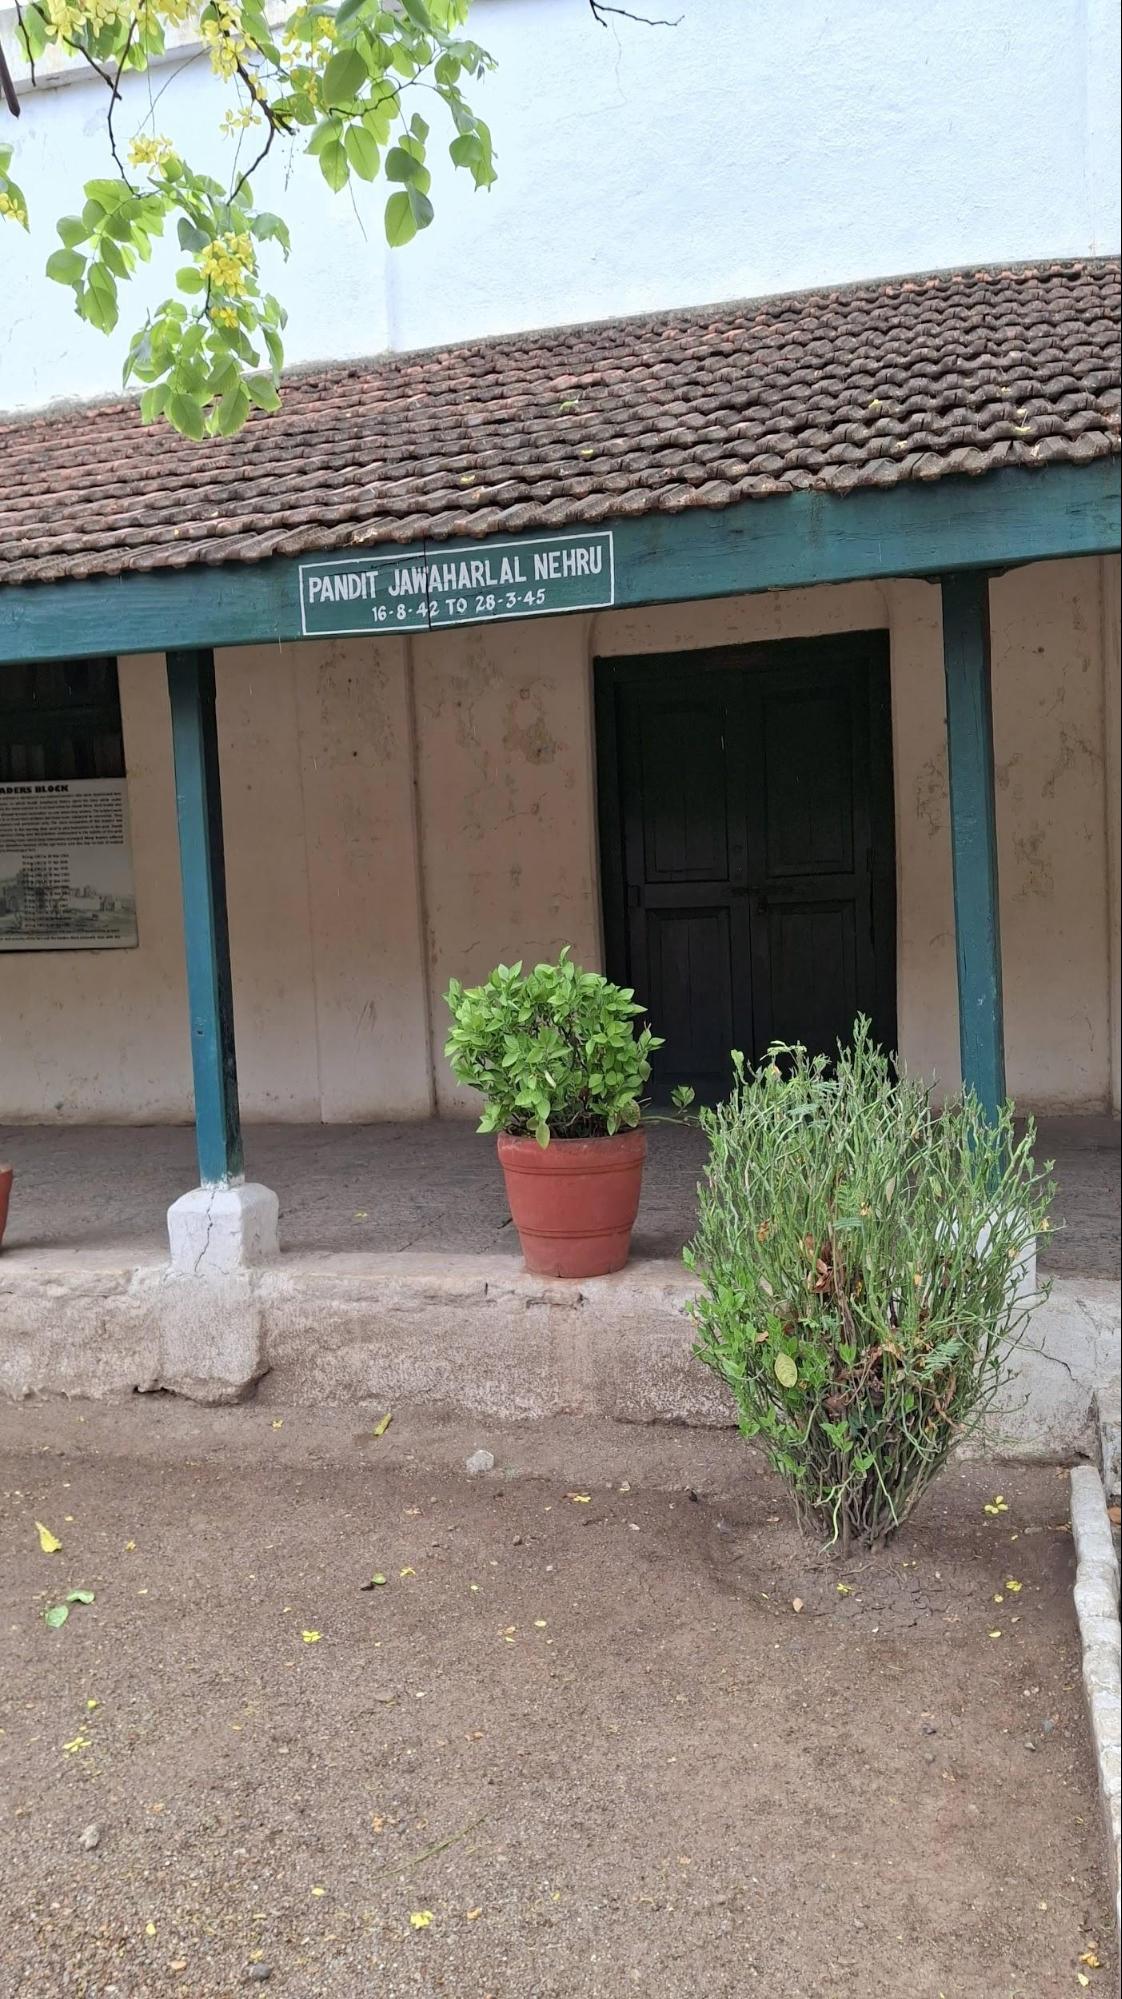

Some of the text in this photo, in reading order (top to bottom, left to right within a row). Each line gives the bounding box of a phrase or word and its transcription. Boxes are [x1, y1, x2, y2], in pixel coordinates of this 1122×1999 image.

[308, 545, 602, 603] PANDIT JAWAHARLAL NEHRU
[372, 589, 546, 622] 16-8-42 TO 28-3-45
[35, 784, 69, 793] BLOCK
